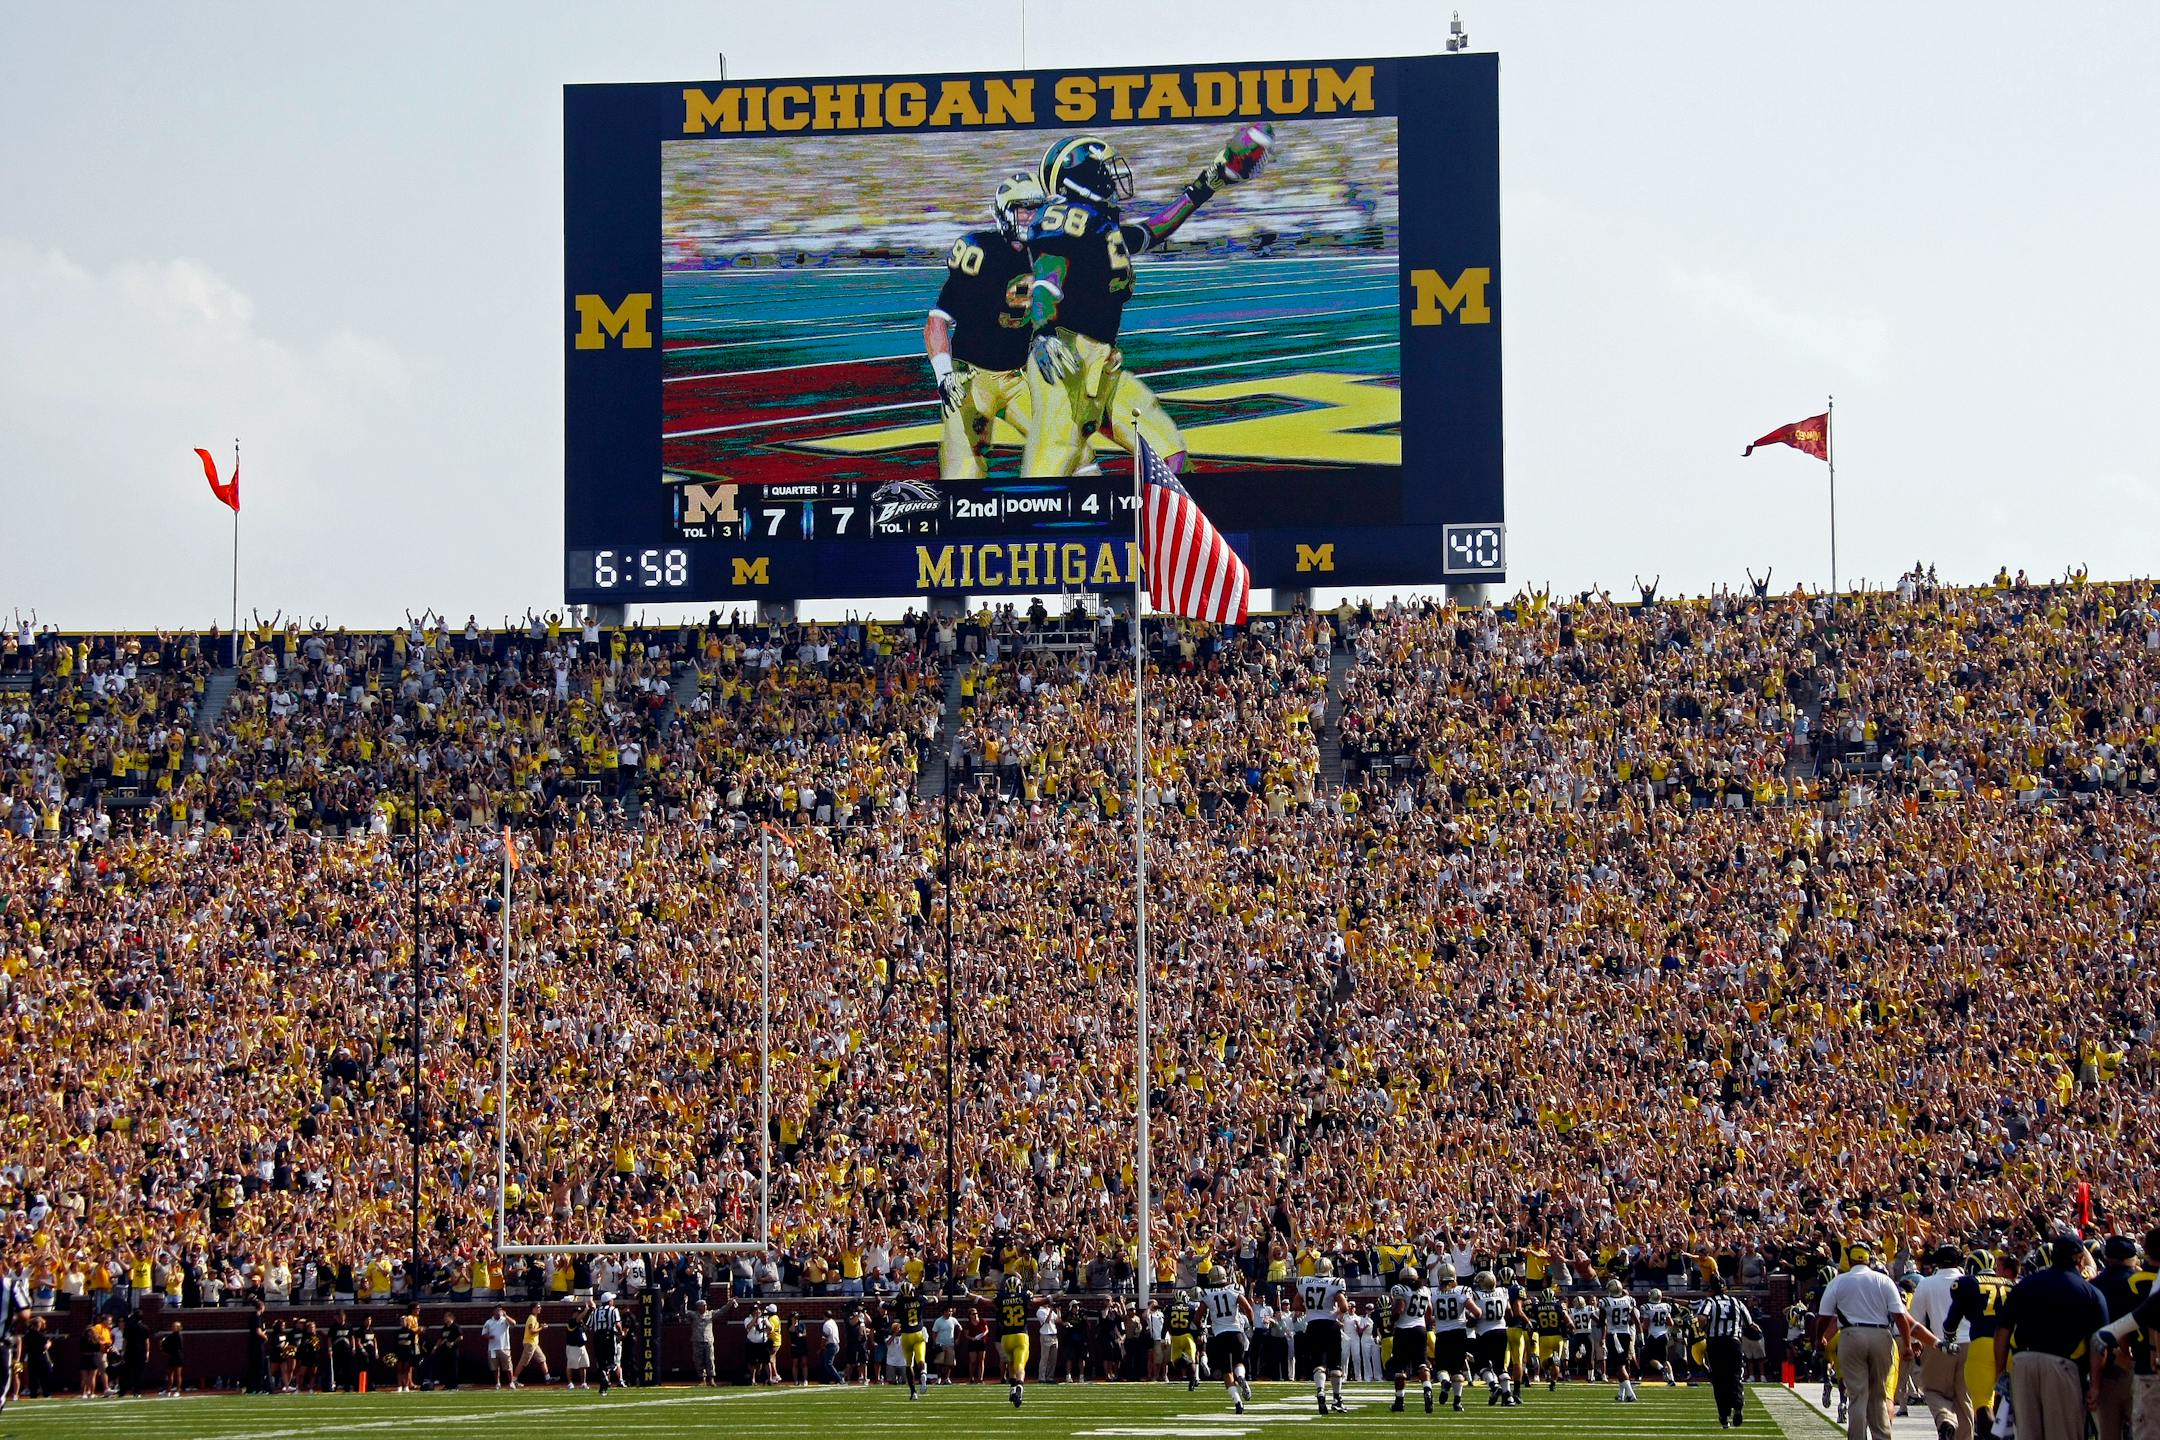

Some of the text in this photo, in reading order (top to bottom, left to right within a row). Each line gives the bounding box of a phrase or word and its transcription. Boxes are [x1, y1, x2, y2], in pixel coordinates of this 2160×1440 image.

[683, 65, 1375, 133] MICHIGAN STADIUM
[1041, 204, 1089, 238] 58
[947, 238, 985, 276] 90
[1410, 267, 1491, 326] M
[575, 293, 653, 350] M
[771, 484, 841, 496] QUARTER 2
[684, 484, 739, 523] M
[876, 501, 939, 524] BRONCOS
[956, 497, 998, 518] 2nd
[1006, 498, 1062, 512] DOWN
[1081, 493, 1100, 515] 4
[682, 525, 731, 538] TOL 3
[763, 507, 855, 536] 7 7
[880, 521, 929, 533] TOL 2
[1296, 543, 1335, 572] M
[1450, 529, 1499, 567] 40
[595, 549, 687, 588] 6:58
[731, 557, 770, 585] M
[1376, 769, 1388, 777] 13
[1214, 1293, 1232, 1318] 11
[1305, 1286, 1326, 1310] 67
[1406, 1294, 1429, 1318] 65
[1436, 1297, 1458, 1320] 68
[1485, 1299, 1503, 1321] 60
[1003, 1305, 1024, 1326] 32
[1171, 1311, 1189, 1328] 25
[1538, 1312, 1557, 1328] 68
[1574, 1314, 1588, 1329] 29
[1612, 1307, 1629, 1325] 83
[642, 1294, 653, 1381] MICHIGAN
